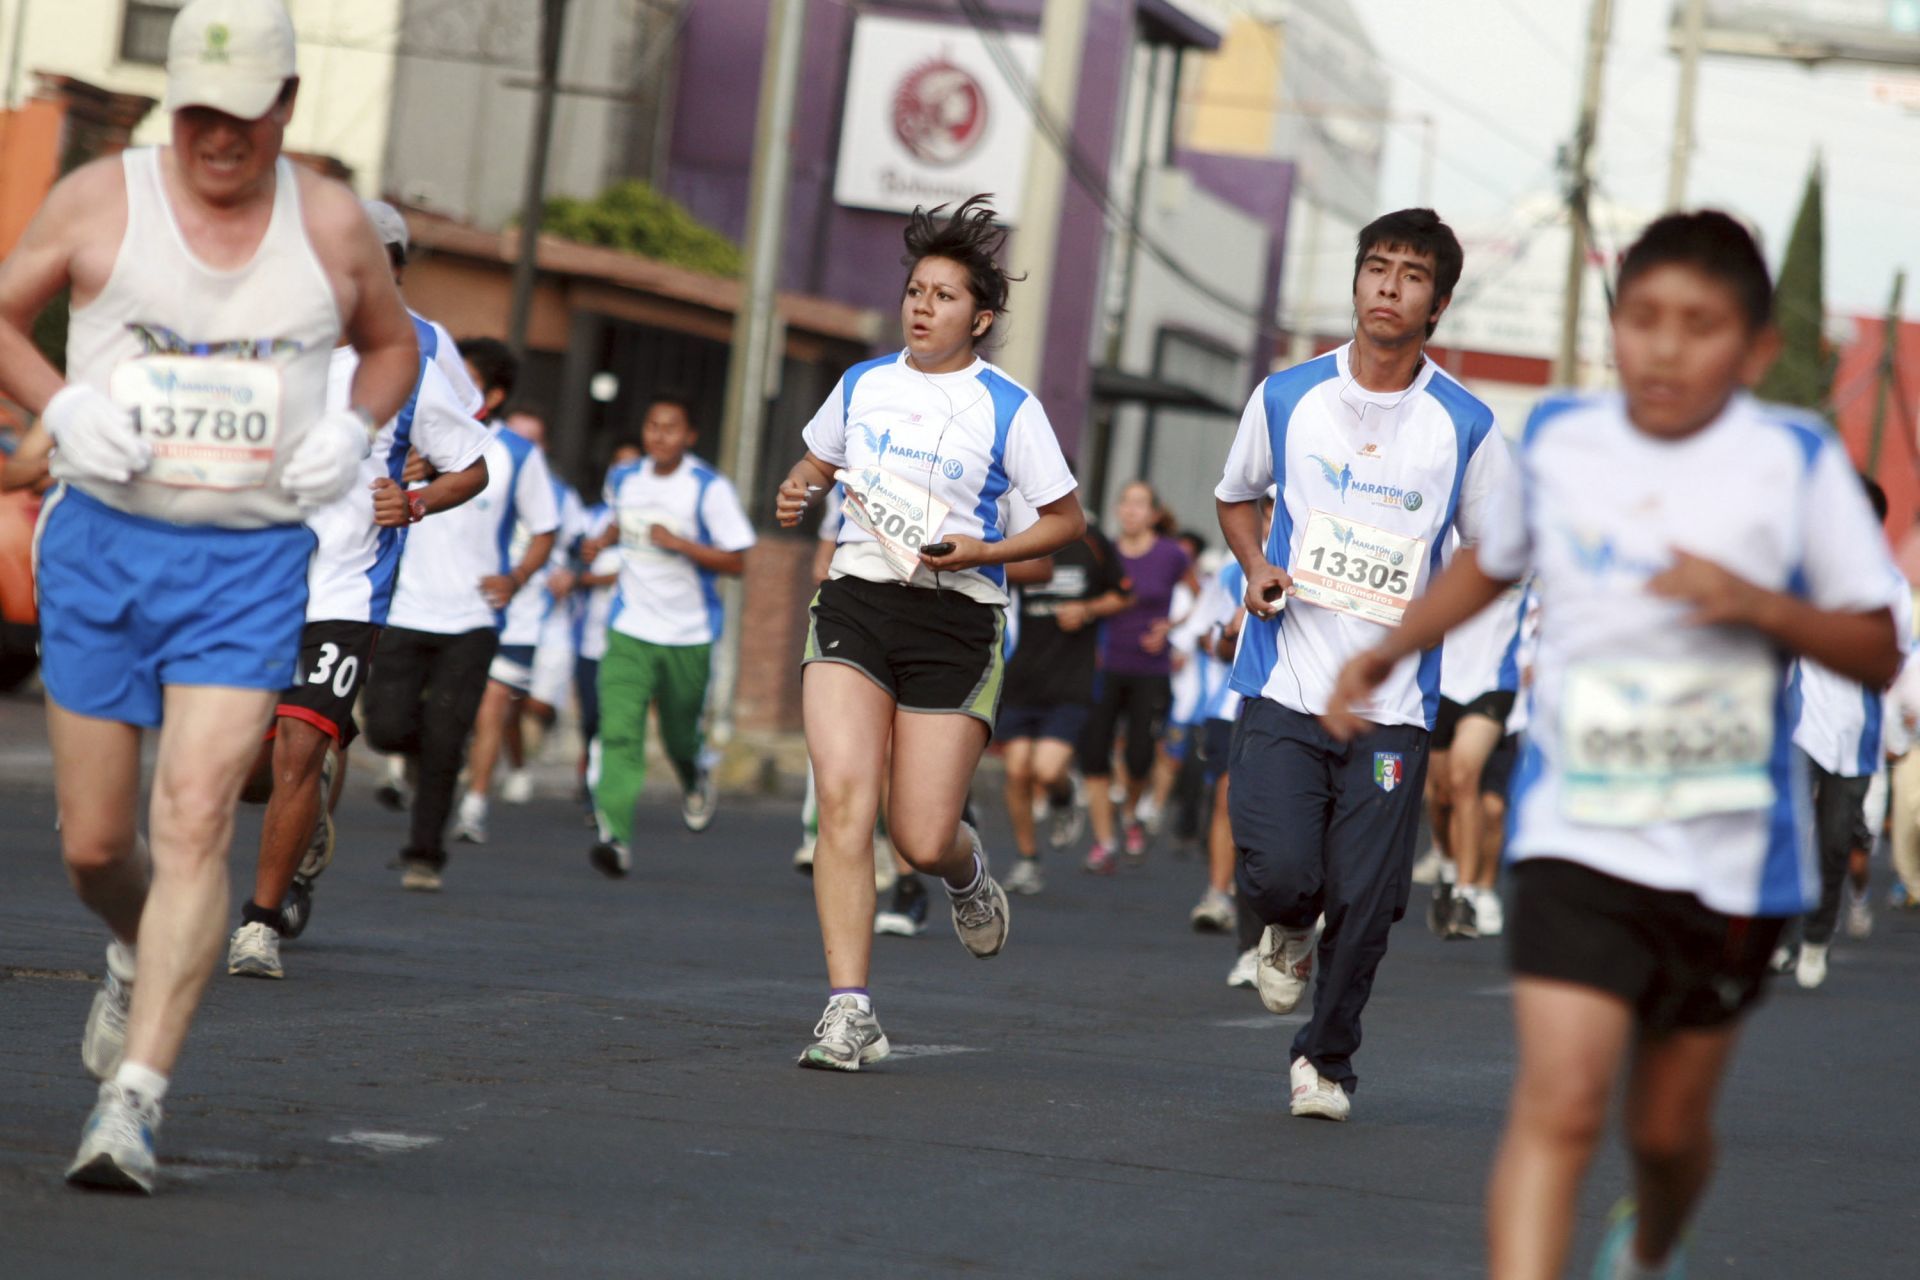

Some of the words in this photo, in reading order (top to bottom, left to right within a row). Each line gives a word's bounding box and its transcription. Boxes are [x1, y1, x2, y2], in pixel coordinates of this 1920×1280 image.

[129, 405, 267, 442] 13780
[889, 445, 943, 465] MARATÓN
[1351, 480, 1404, 498] MARATÓN
[1310, 546, 1409, 594] 13305
[1321, 577, 1332, 588] 10
[308, 642, 358, 698] 30
